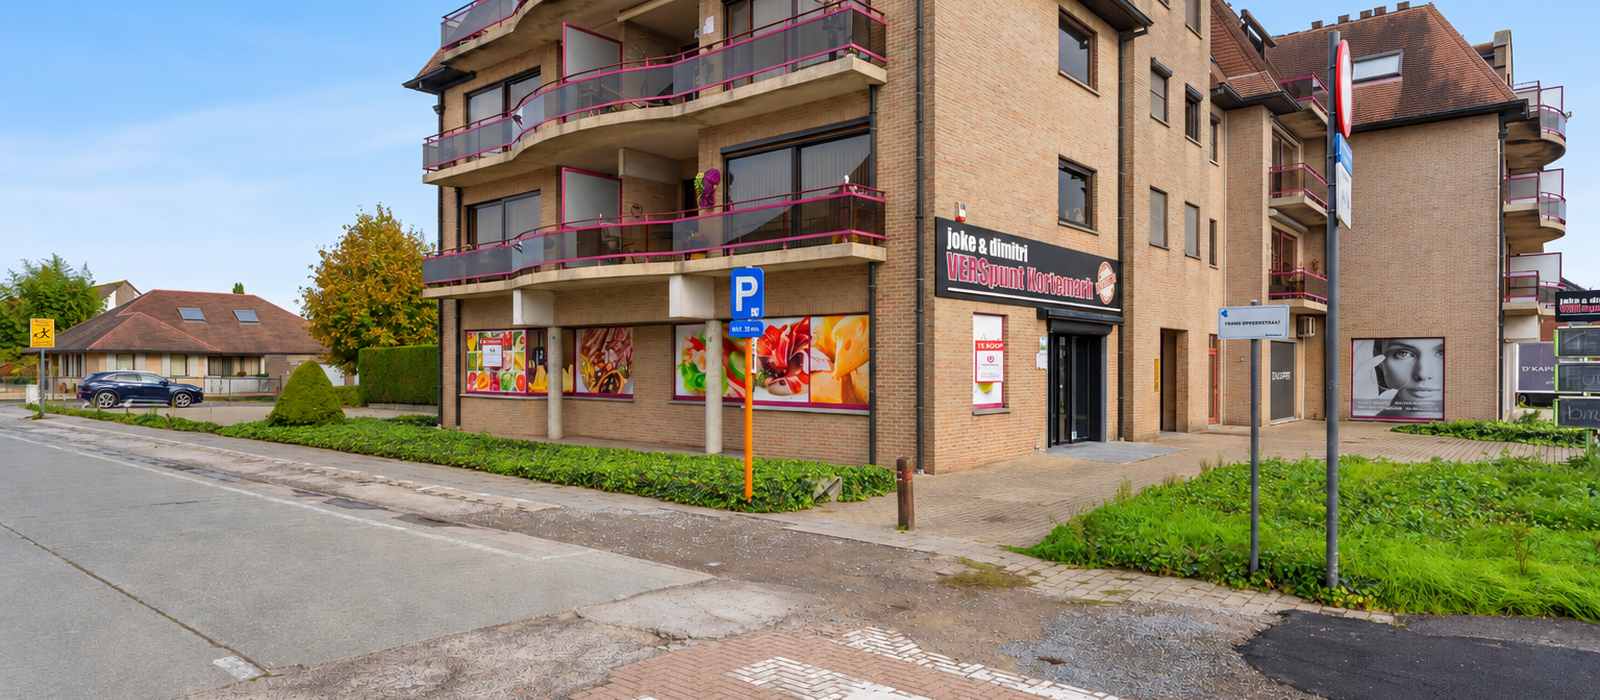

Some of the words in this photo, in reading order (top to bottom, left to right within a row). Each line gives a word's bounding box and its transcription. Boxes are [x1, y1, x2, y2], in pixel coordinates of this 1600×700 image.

[946, 226, 977, 253] joke
[978, 237, 988, 255] &
[989, 237, 1028, 263] dimitri
[735, 276, 759, 312] P
[946, 251, 1025, 290] VERSpunt
[1026, 266, 1094, 300] Kortemark
